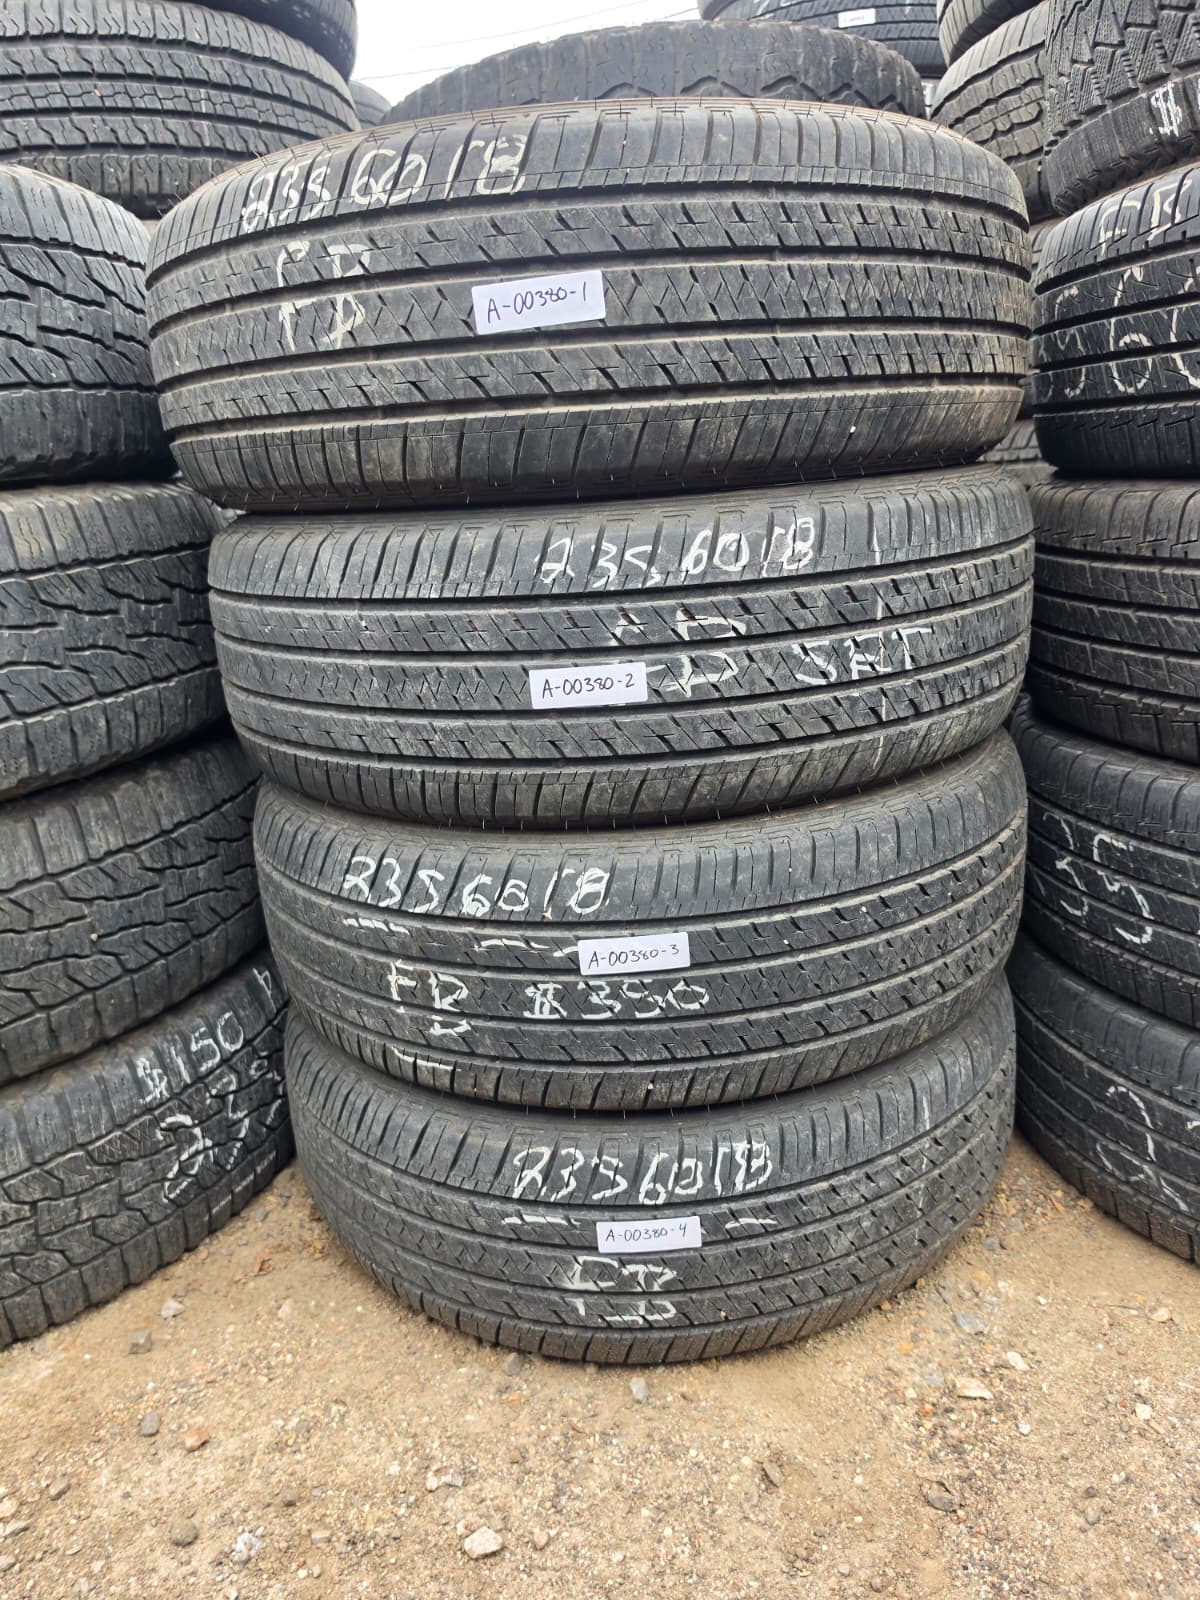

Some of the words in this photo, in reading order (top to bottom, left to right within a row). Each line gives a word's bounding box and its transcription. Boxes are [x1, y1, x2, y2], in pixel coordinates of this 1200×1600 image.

[486, 280, 587, 324] A-00380-1
[541, 672, 636, 700] A-00380-2
[342, 856, 446, 914] 235
[587, 943, 681, 970] A-00380-3
[511, 1145, 629, 1202] 235
[604, 1222, 690, 1243] A-00380-4
